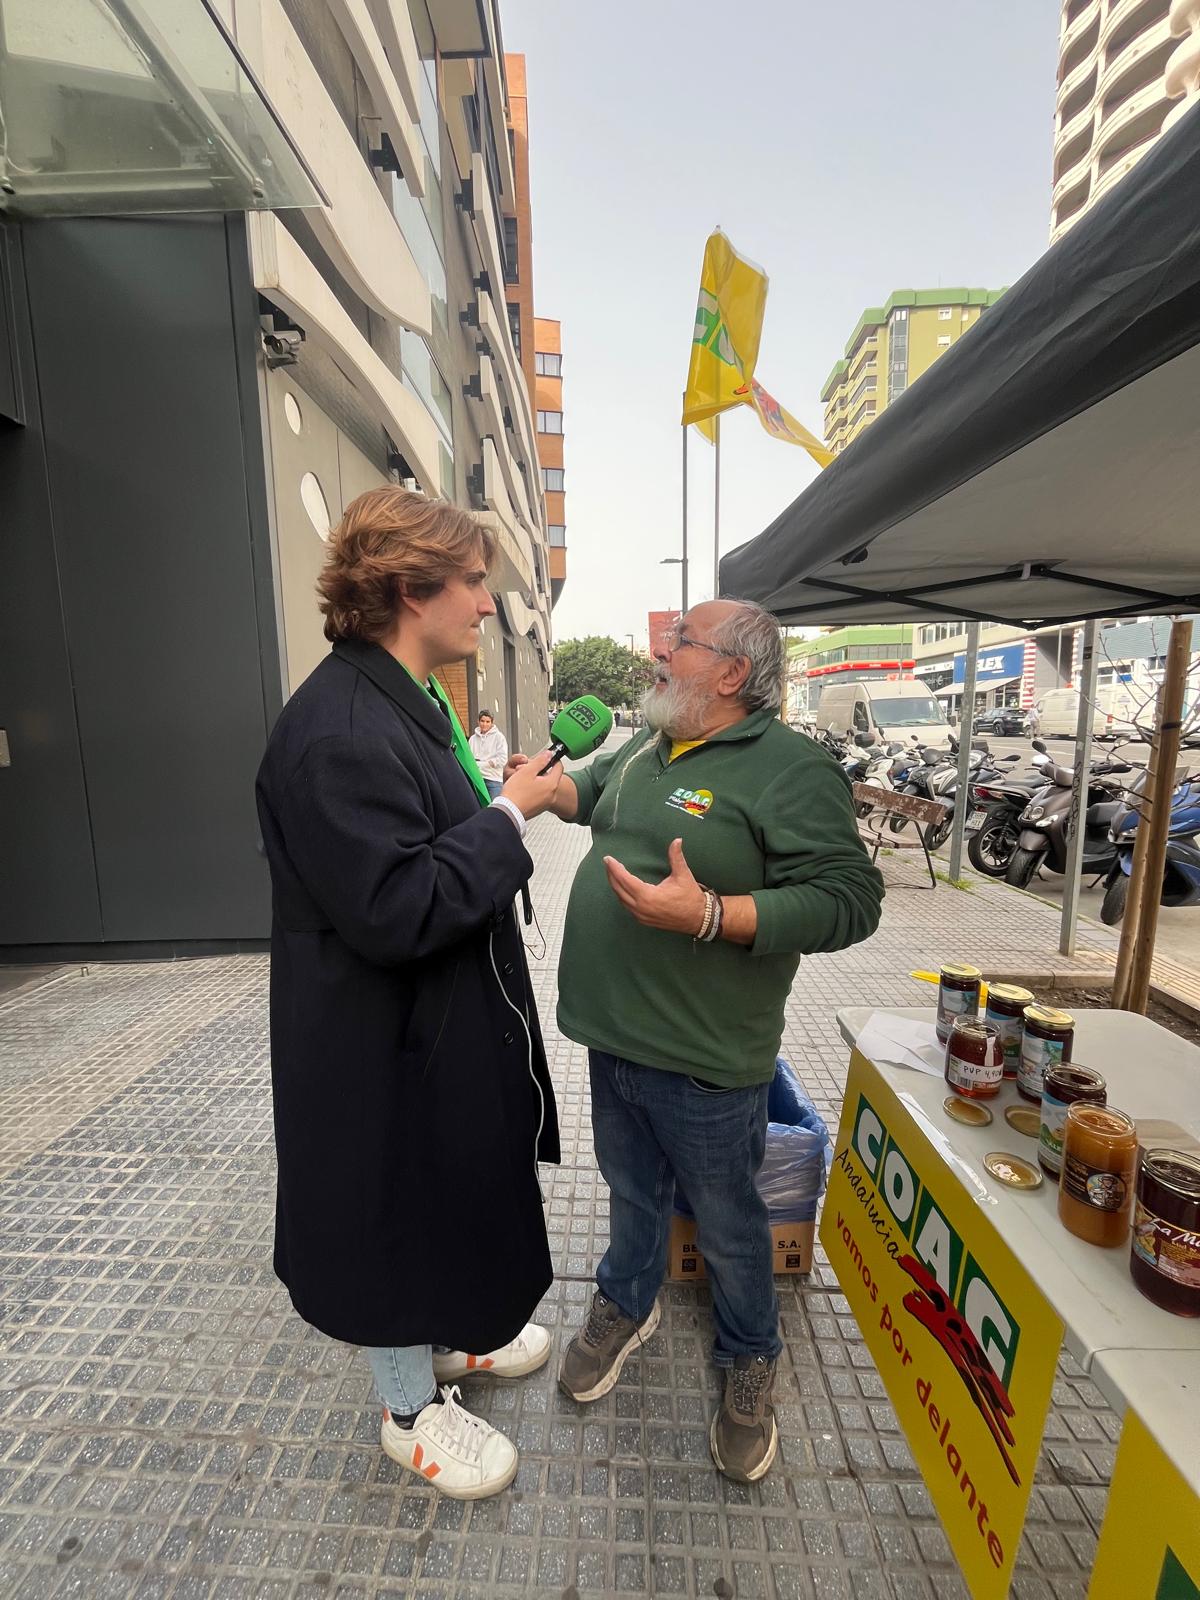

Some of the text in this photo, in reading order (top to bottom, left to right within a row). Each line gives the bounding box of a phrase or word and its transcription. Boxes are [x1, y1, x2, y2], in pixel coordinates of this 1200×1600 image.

[963, 1065, 981, 1076] PVP
[777, 1239, 801, 1249] S.A.
[857, 1107, 1013, 1384] COAG
[837, 1211, 1004, 1568] vamos por delante
